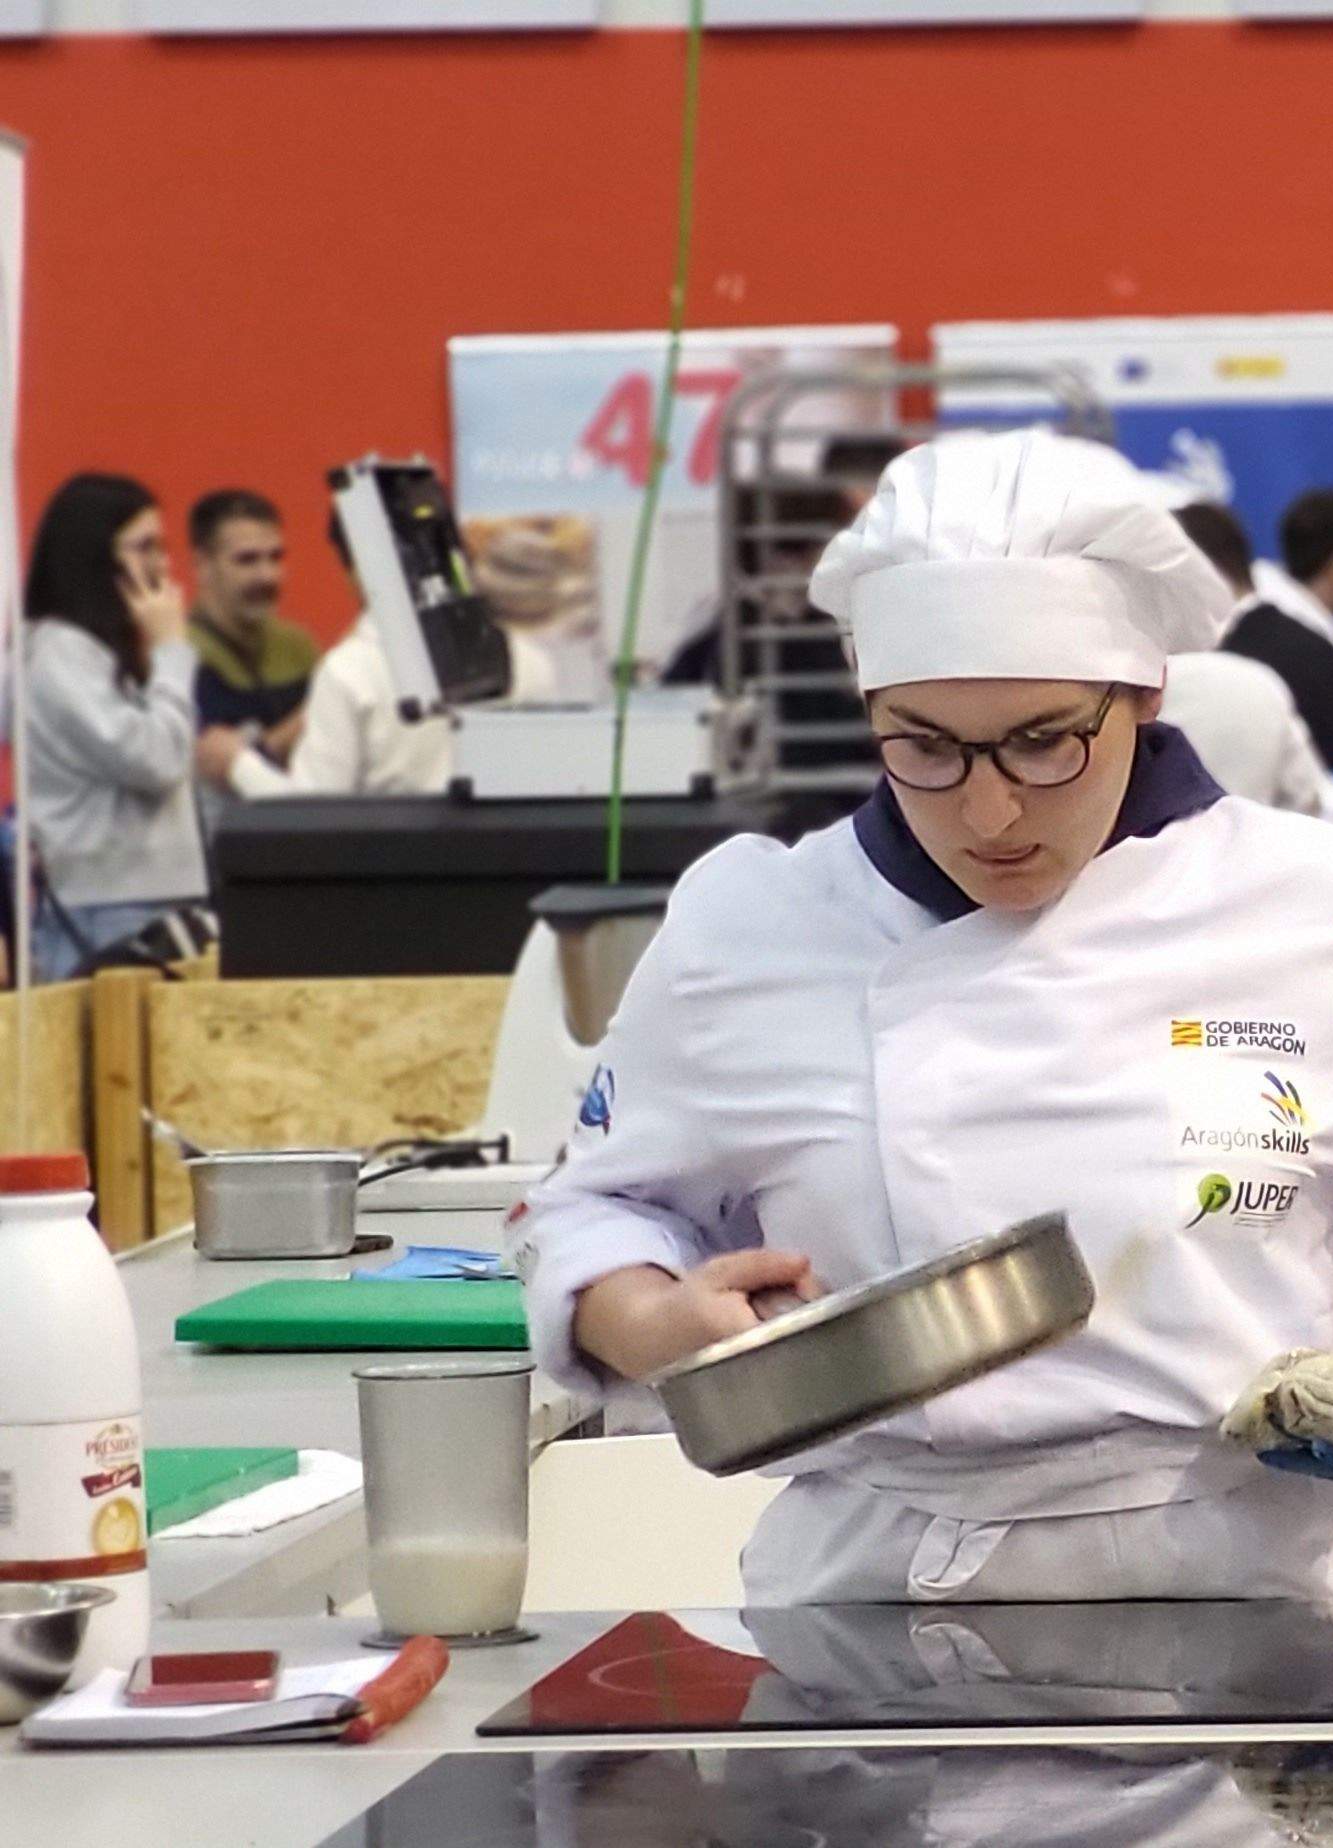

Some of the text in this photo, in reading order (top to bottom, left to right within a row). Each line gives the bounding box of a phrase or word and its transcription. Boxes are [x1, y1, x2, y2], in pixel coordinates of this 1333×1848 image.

[1205, 1020, 1296, 1036] GOBIERNO
[1206, 1035, 1306, 1056] DE ARAGON
[1181, 1125, 1311, 1155] Aragónskills
